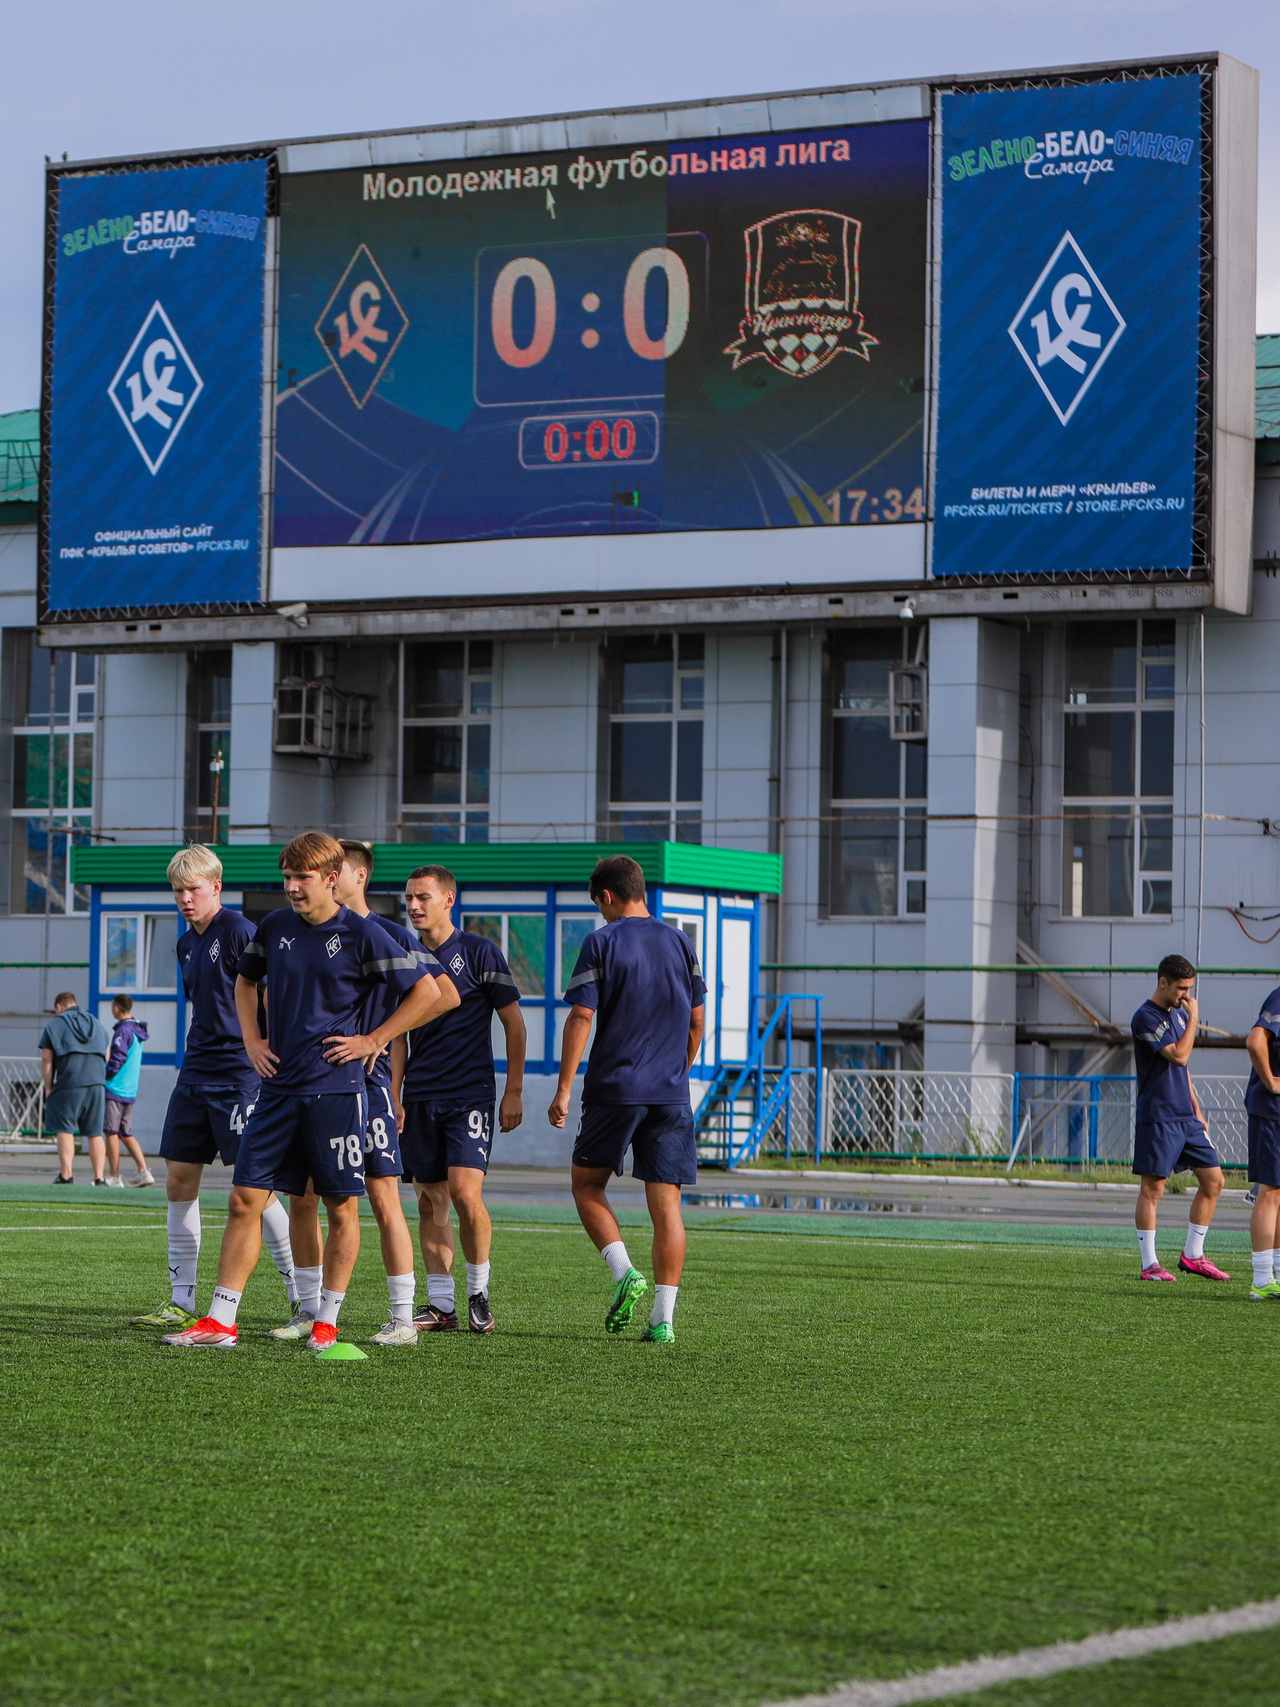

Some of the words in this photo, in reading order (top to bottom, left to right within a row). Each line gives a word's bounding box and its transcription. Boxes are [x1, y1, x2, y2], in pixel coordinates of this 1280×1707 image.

[363, 164, 558, 201] Молодежная
[567, 146, 767, 190] футбольная
[775, 139, 851, 167] лига
[1024, 152, 1114, 185] Самара
[123, 229, 196, 259] Самара
[543, 418, 637, 462] 0:00
[826, 485, 927, 523] 17:34
[970, 486, 1024, 500] БИЛЕТЫ
[1026, 486, 1036, 498] И
[1039, 484, 1076, 498] МЕРЧ
[1078, 481, 1157, 497] «КРЫЛЬЕВ»
[943, 502, 1064, 518] PFCKS.RU/TICKETS
[1075, 497, 1185, 513] STORE.PFCKS.RU
[94, 525, 181, 542] ОФИЦИАЛЬНЫЙ
[182, 523, 213, 538] САЙТ
[59, 547, 85, 559] ПФК
[86, 544, 137, 557] «КРЫЛЬЯ
[137, 541, 195, 555] СОВЕТОВ»
[196, 538, 249, 552] PFCKS.RU
[467, 1110, 490, 1143] 93
[329, 1134, 363, 1171] 78
[214, 1292, 237, 1304] FILA
